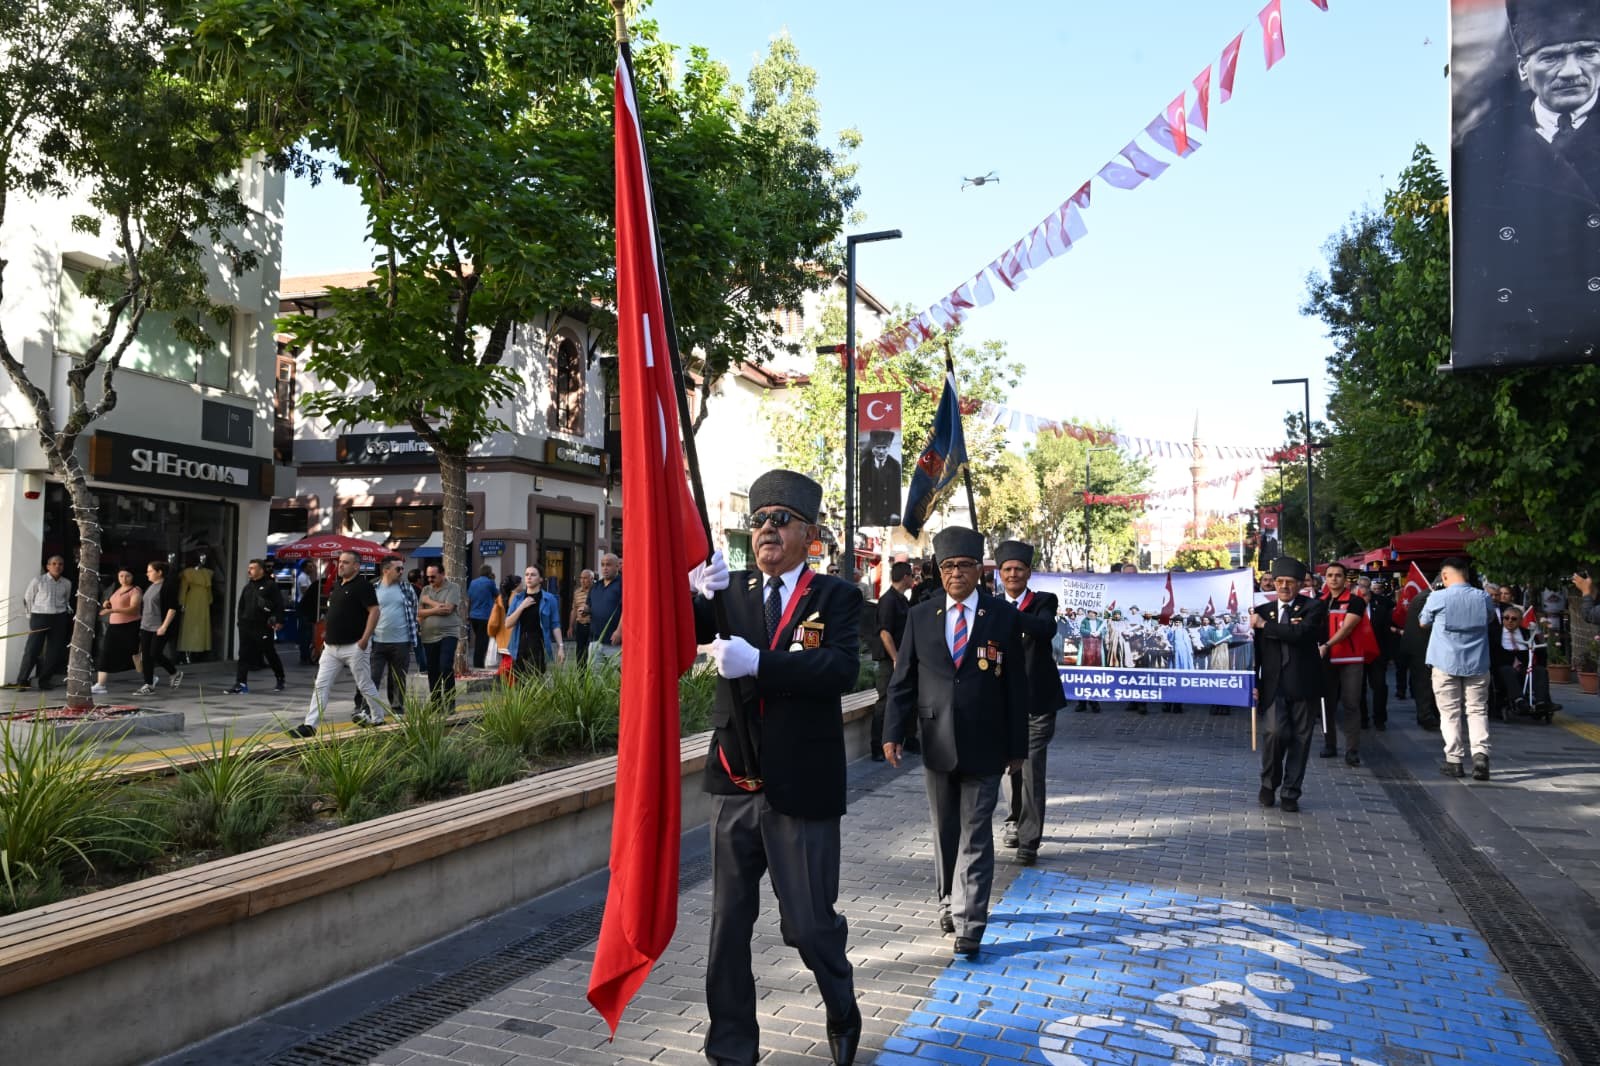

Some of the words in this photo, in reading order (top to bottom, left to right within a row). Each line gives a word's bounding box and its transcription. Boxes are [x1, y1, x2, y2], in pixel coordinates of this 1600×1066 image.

[1118, 673, 1177, 687] GAZİLER
[1180, 675, 1243, 689] DERNEĞİ
[1074, 687, 1110, 700] UŞAK
[1114, 687, 1162, 701] ŞUBESİ
